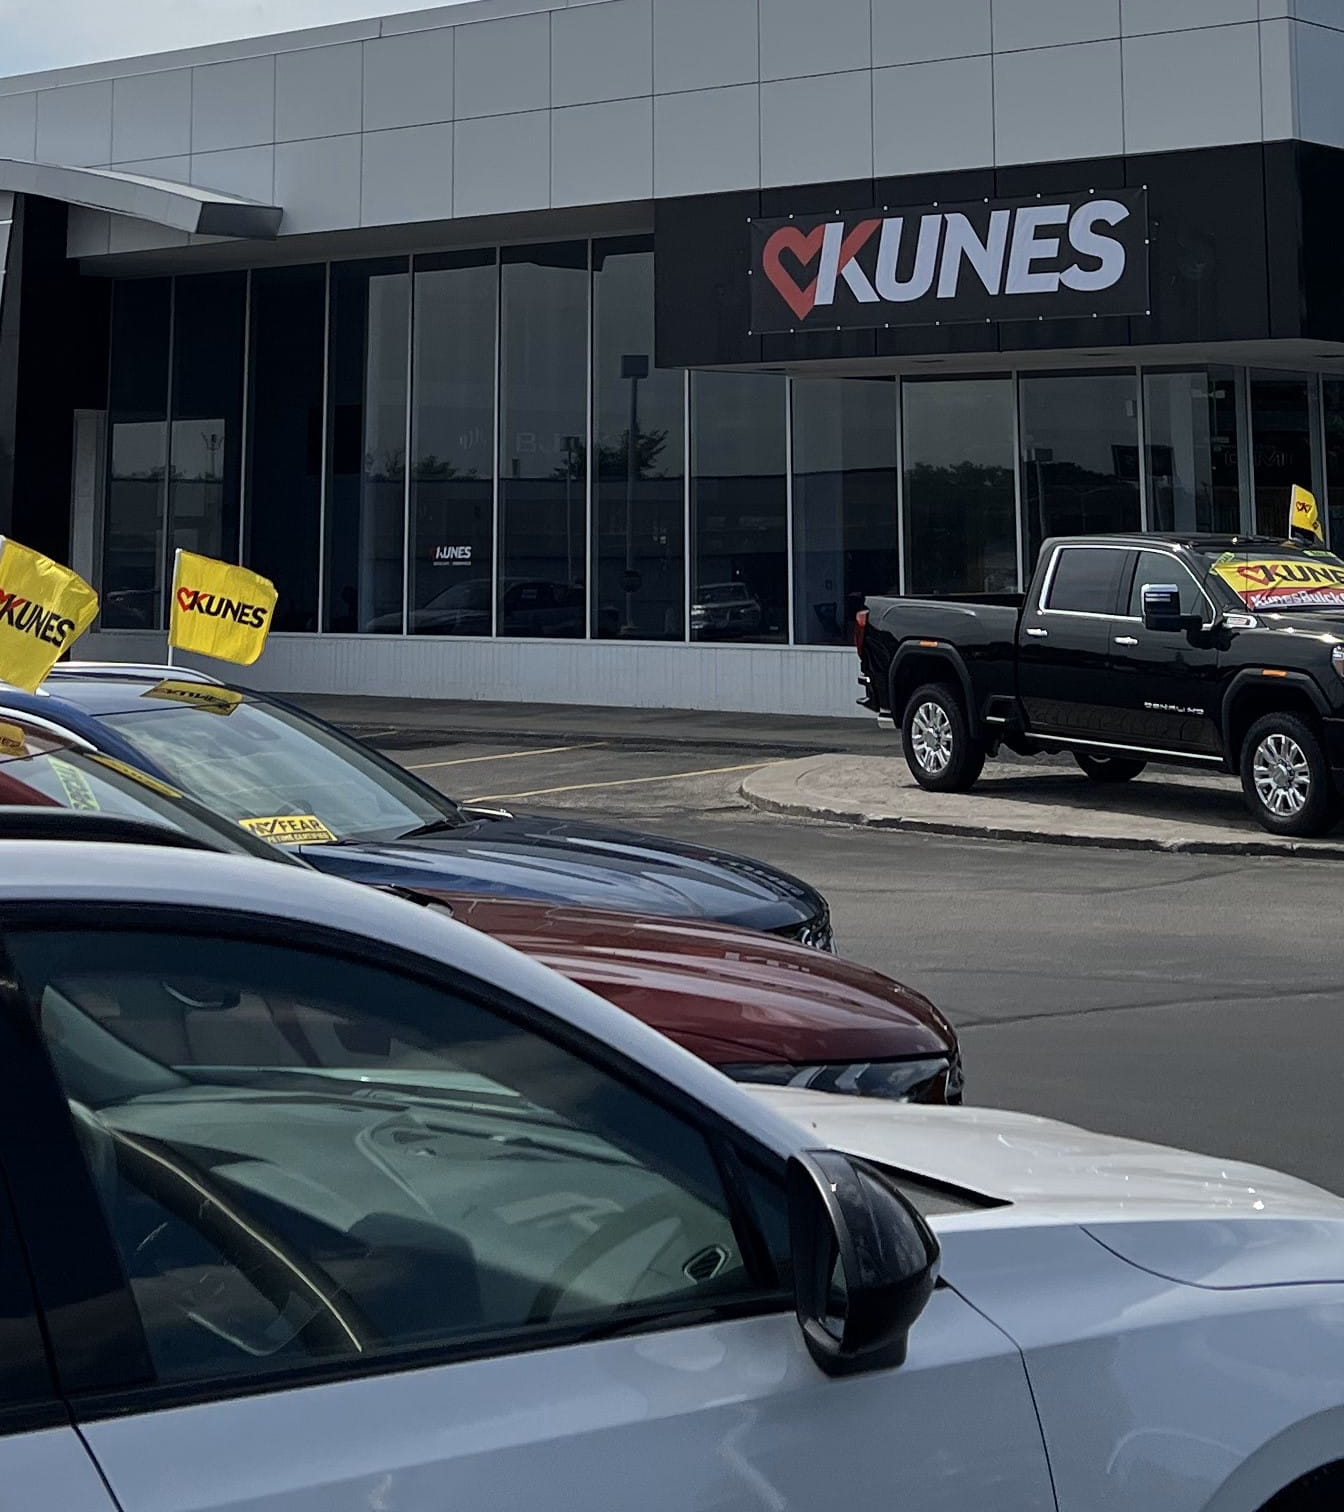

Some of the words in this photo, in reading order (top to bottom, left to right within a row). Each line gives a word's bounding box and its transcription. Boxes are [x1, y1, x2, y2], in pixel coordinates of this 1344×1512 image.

[812, 199, 1131, 306] KUNES
[189, 591, 268, 628] KUNES
[278, 819, 324, 832] FEAR
